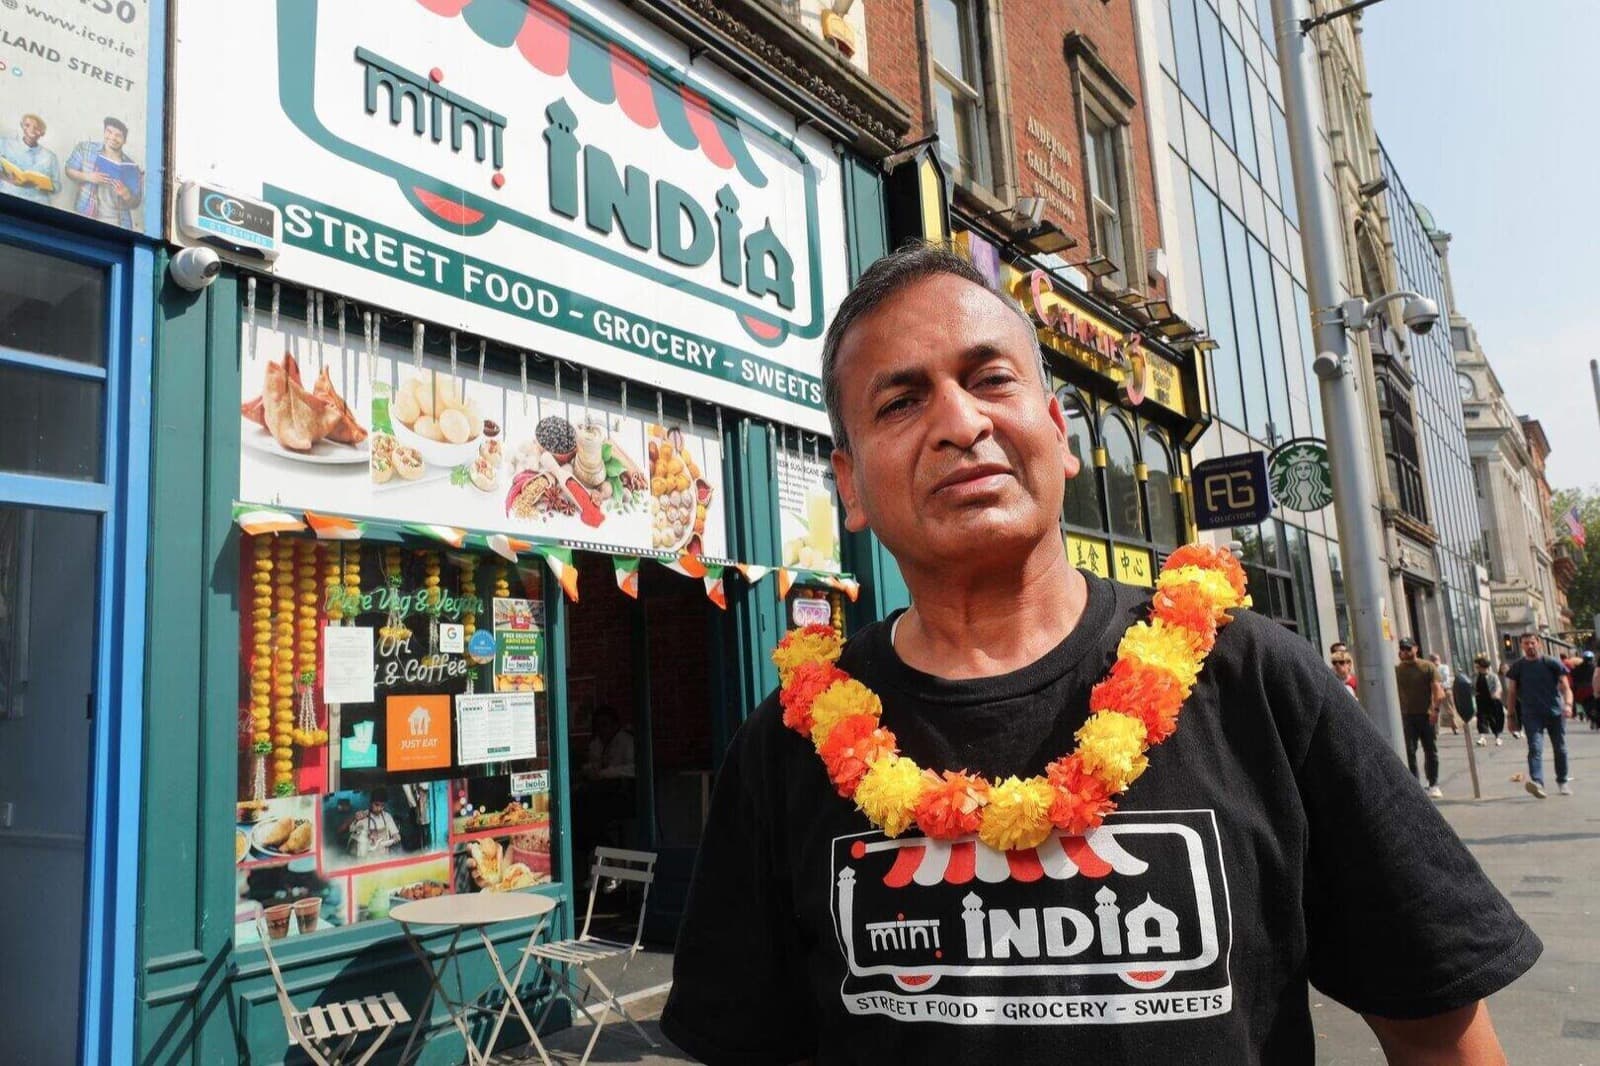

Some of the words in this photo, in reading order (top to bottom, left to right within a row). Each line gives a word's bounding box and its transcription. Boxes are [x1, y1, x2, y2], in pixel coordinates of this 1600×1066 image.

[25, 5, 136, 57] www.icot.ie
[0, 29, 60, 63] LAND
[68, 57, 135, 92] STREET
[354, 45, 508, 190] mini
[542, 96, 796, 311] INDIA
[284, 203, 450, 284] STREET
[463, 263, 560, 319] FOOD
[593, 309, 717, 369] GROCERY
[741, 359, 822, 403] SWEETS
[405, 653, 467, 683] Coffee
[400, 739, 420, 750] JUST
[421, 737, 439, 748] EAT
[865, 913, 943, 959] mini
[962, 885, 1181, 959] INDIA
[856, 996, 918, 1015] STREET
[926, 1000, 978, 1018] FOOD
[1002, 1002, 1108, 1020] GROCERY
[1135, 994, 1223, 1016] SWEETS
